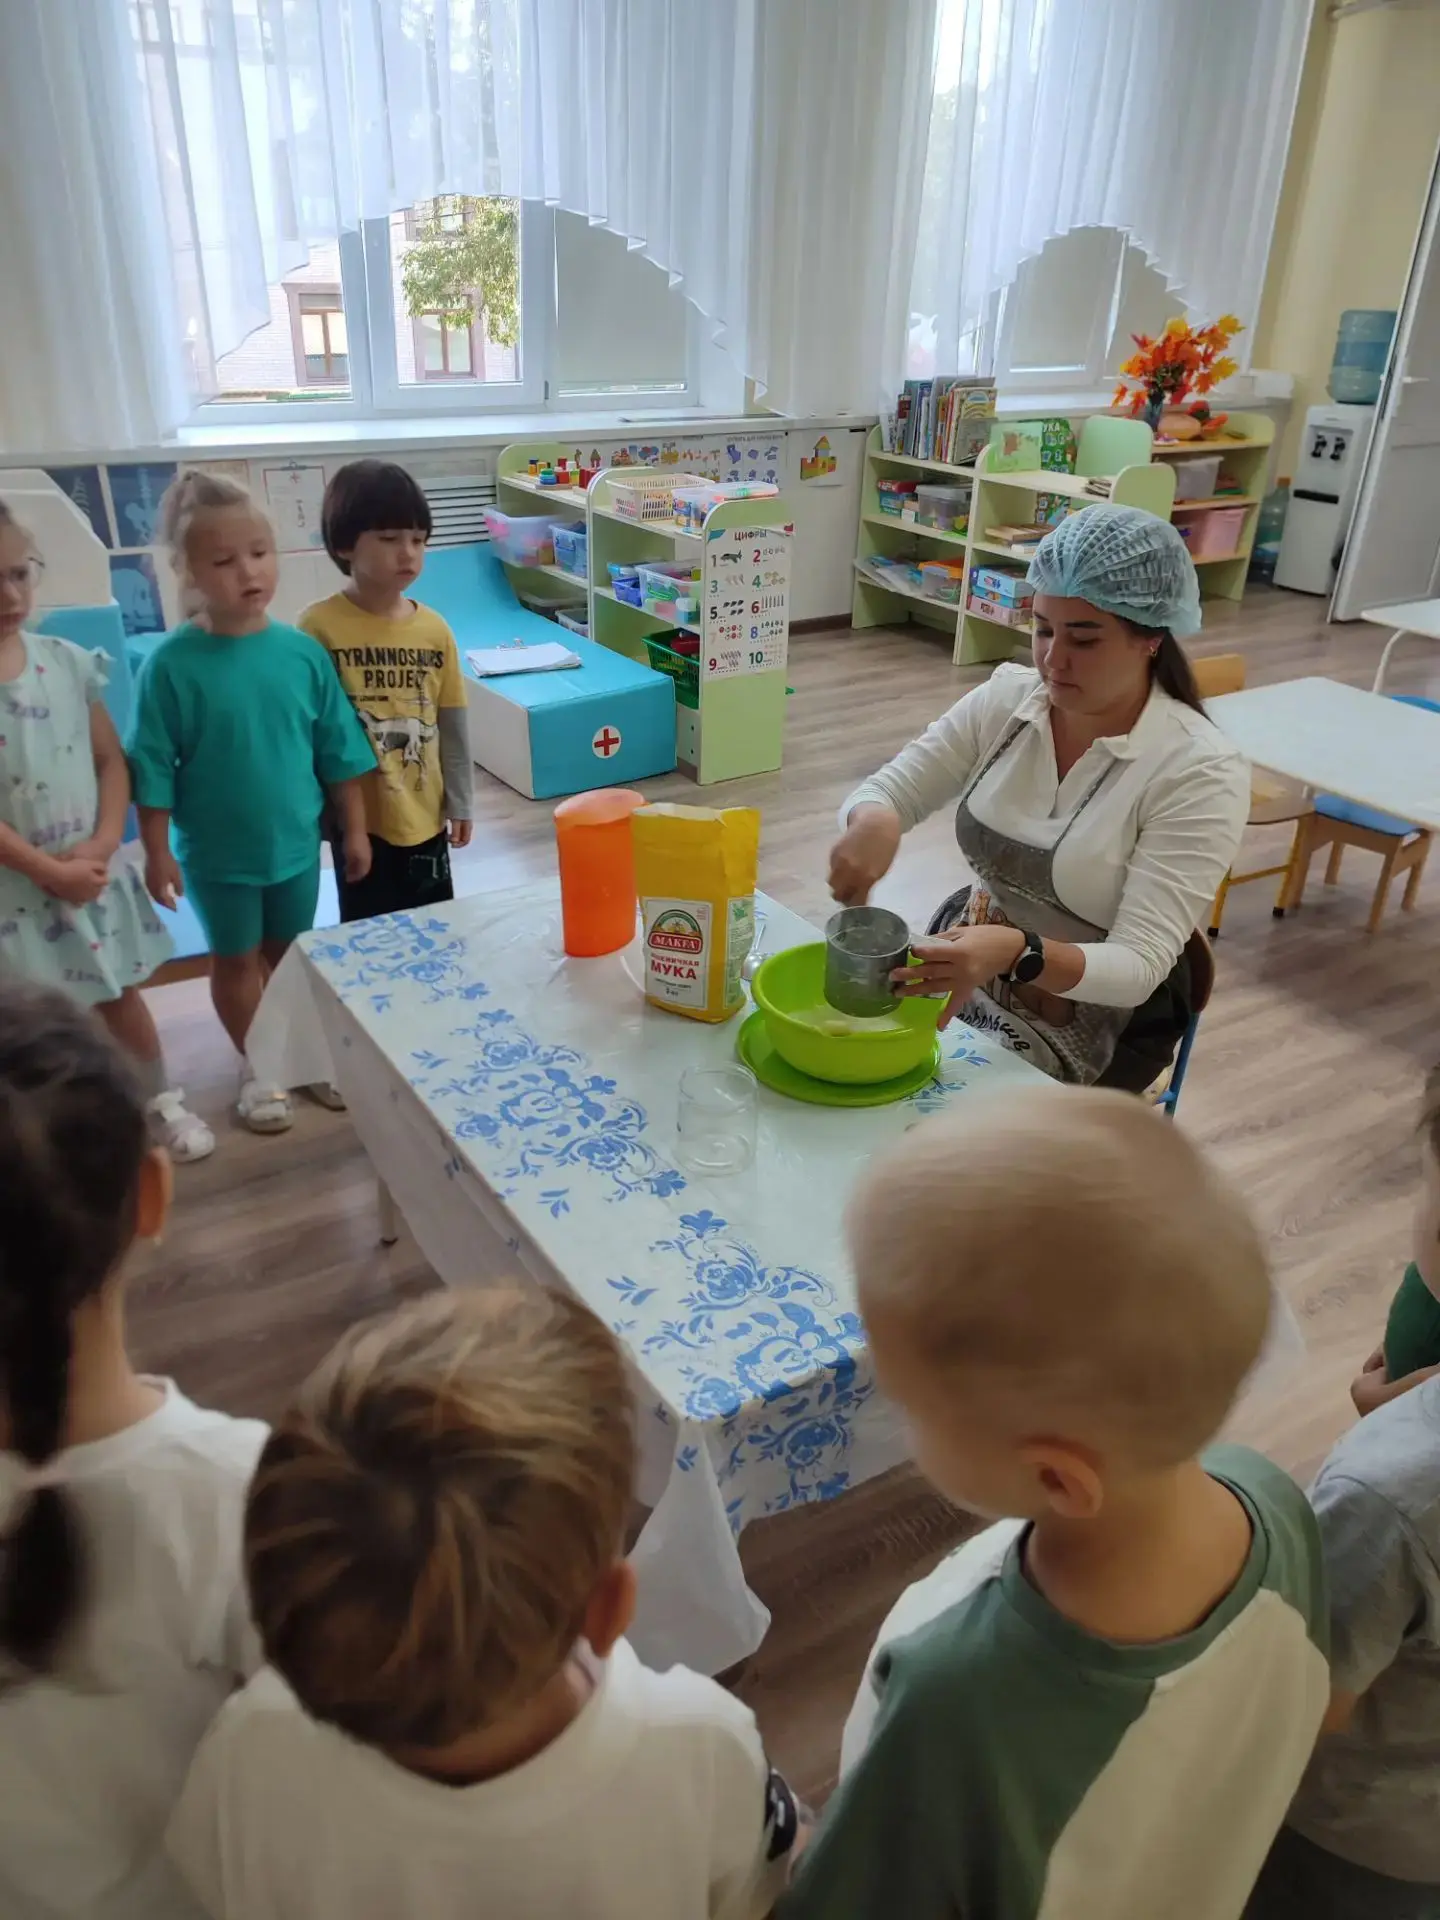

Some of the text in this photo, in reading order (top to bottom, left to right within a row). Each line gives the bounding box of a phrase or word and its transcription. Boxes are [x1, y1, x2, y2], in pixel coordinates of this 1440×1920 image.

[734, 529, 767, 541] ЦИФРЫ
[711, 549, 761, 568] 1 2
[710, 575, 761, 594] 3 4
[710, 601, 760, 620] 5 6
[709, 626, 758, 645] 7 8
[709, 651, 763, 671] 9 10
[651, 959, 697, 980] МУКА
